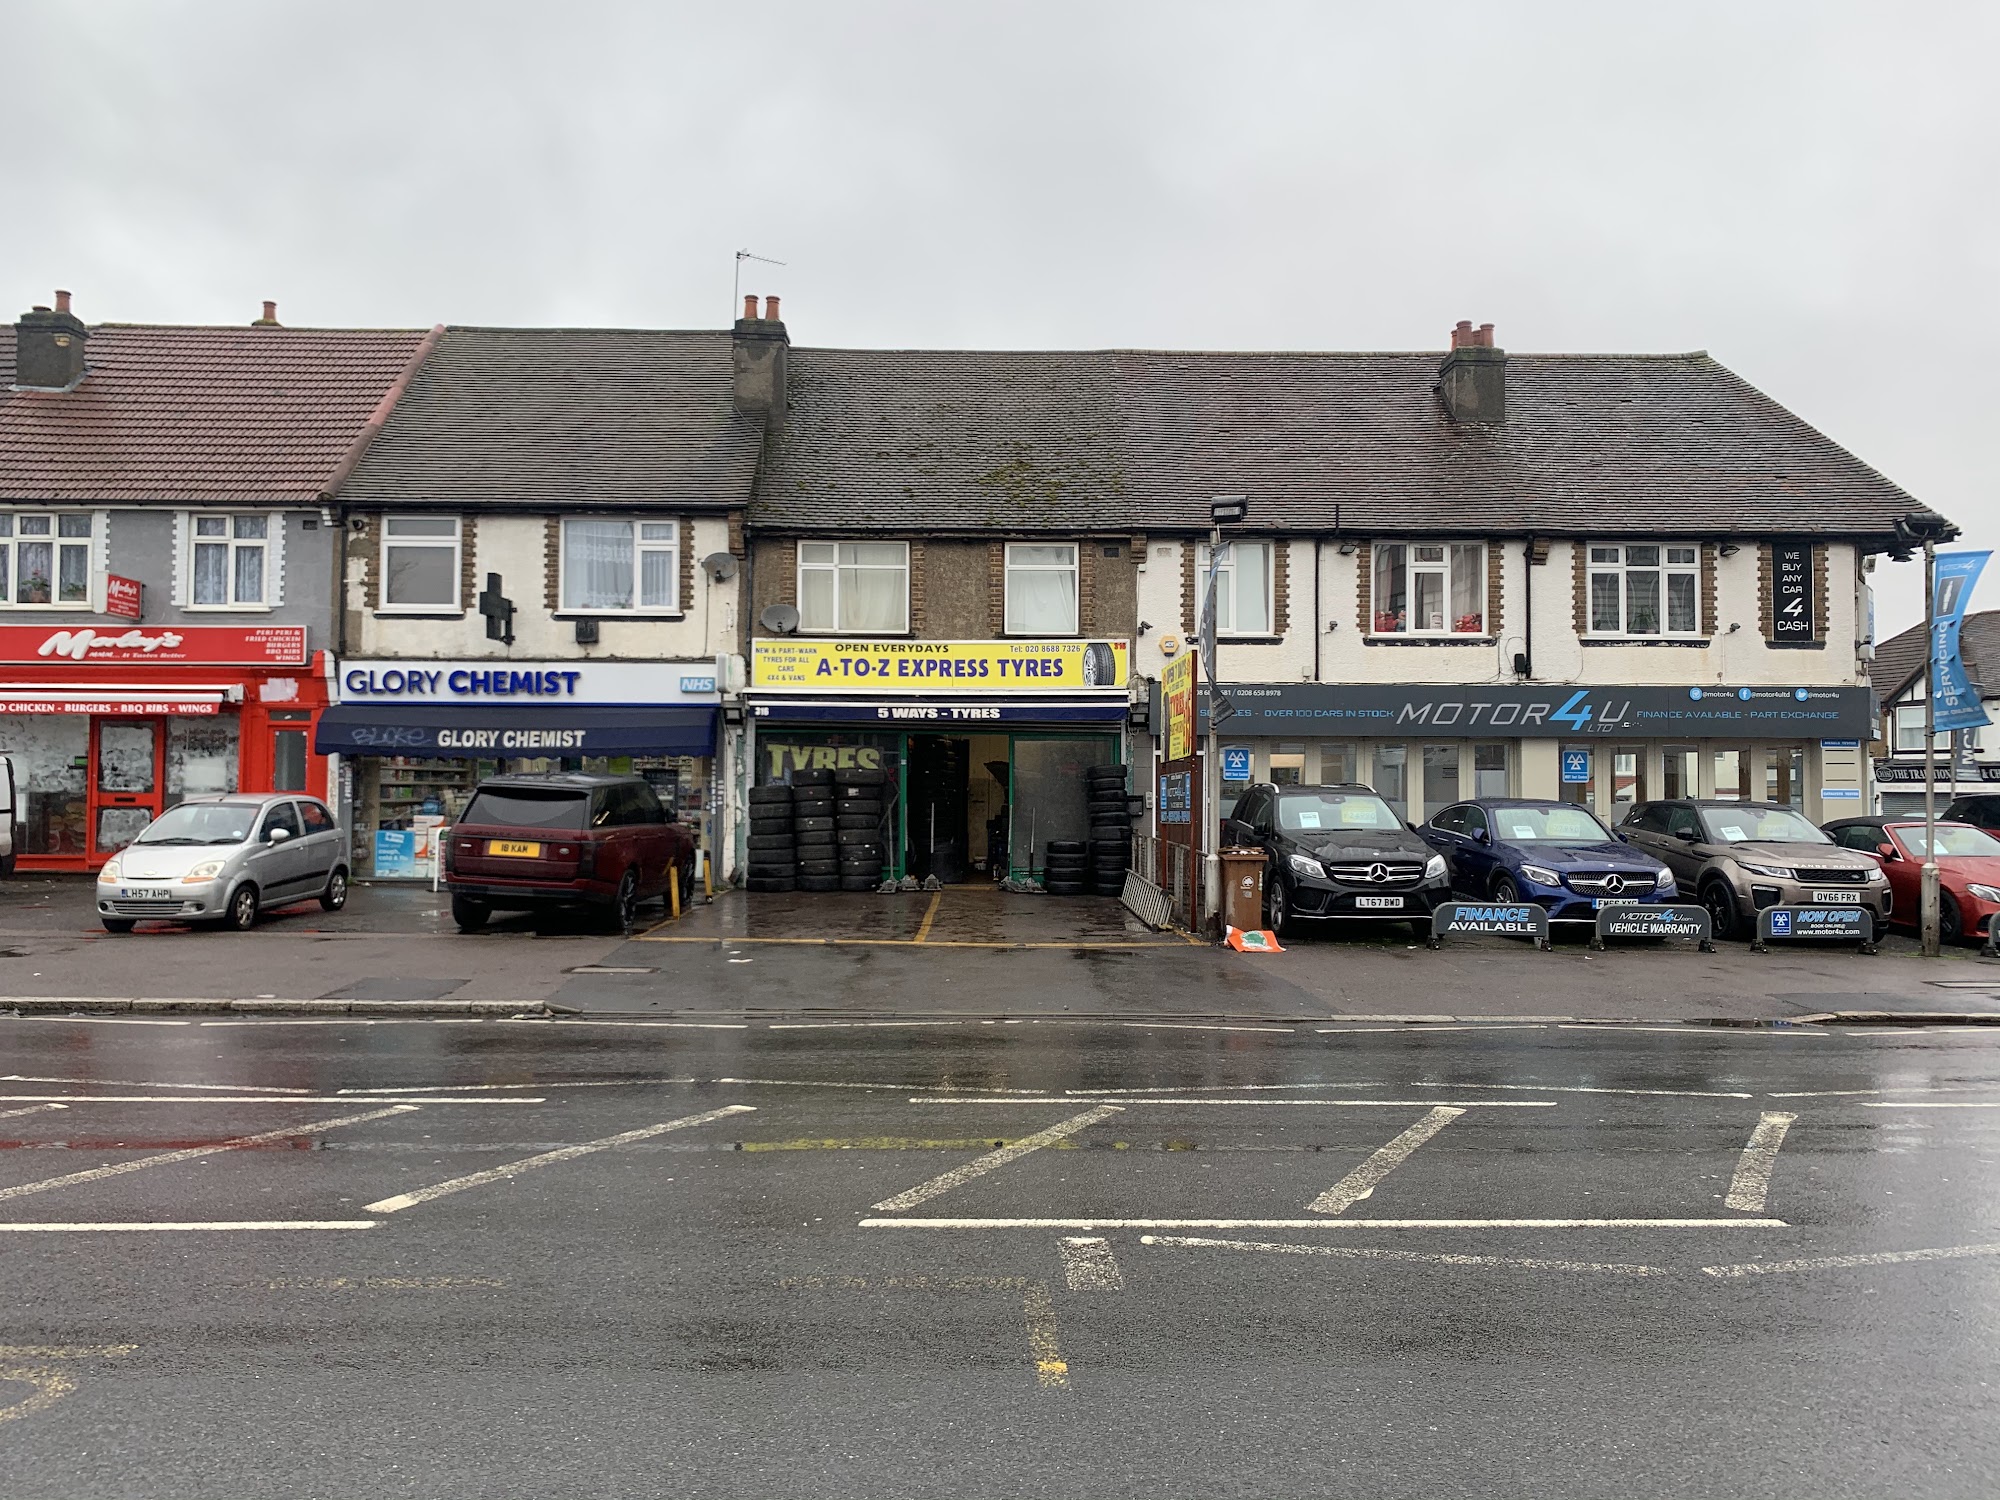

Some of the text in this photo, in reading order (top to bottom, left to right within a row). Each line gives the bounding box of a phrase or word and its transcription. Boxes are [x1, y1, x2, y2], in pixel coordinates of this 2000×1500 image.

[1785, 551, 1800, 559] WE
[1782, 563, 1802, 571] BUY
[1783, 598, 1803, 616] 4
[1777, 621, 1808, 630] CASH
[37, 629, 184, 660] Morley's
[835, 643, 949, 653] OPEN EVERYDAYS
[1010, 645, 1081, 653] Tel: 020 8688 7326
[816, 658, 1063, 677] A-TO-Z EXPRESS TYRES
[1939, 621, 1959, 706] SERVICING
[346, 670, 580, 694] GLORY CHEMIST
[682, 679, 712, 690] NHS
[1702, 691, 1734, 699] @motor4u
[1807, 691, 1840, 699] @motor4u
[8, 704, 54, 712] CHICKEN
[64, 704, 111, 712] BURGERS
[121, 704, 143, 713] BBQ
[146, 704, 169, 713] RIBS
[178, 704, 213, 713] WINGS
[754, 707, 769, 716] 316
[878, 708, 889, 718] 5
[892, 708, 938, 718] WAYS
[951, 708, 1000, 718] TYRES
[1751, 711, 1778, 719] PART
[1781, 711, 1839, 719] EXCHANGE
[1587, 723, 1613, 732] LTD
[438, 730, 585, 748] GLORY CHEMIST
[1893, 770, 1909, 779] THE
[126, 890, 169, 898] LH57 AHP
[1817, 893, 1857, 902] OV66 FRX
[1359, 898, 1382, 906] LT67
[1455, 907, 1530, 921] FINANCE
[1797, 911, 1861, 922] NOW OPEN
[1448, 922, 1537, 932] AVAILABLE
[1609, 923, 1702, 934] VEHICLE WARRANTY
